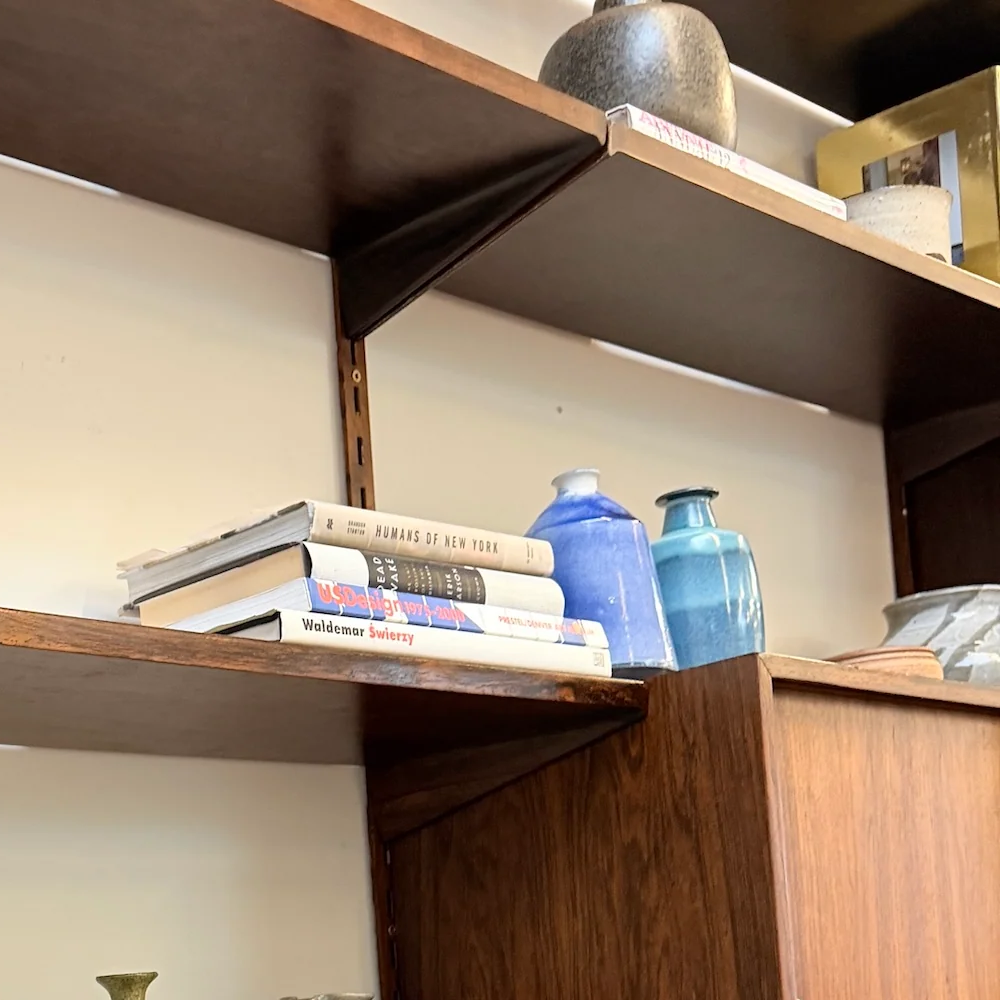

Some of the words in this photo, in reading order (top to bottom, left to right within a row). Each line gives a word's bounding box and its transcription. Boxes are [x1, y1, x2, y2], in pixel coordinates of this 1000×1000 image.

[376, 524, 420, 543] HUMANS
[426, 532, 439, 546] OF
[444, 535, 466, 549] NEW
[472, 538, 499, 554] YORK
[445, 574, 453, 595] ERIK
[452, 568, 463, 599] ARSON
[302, 617, 365, 637] Waldemar
[369, 623, 414, 646] Świerzy
